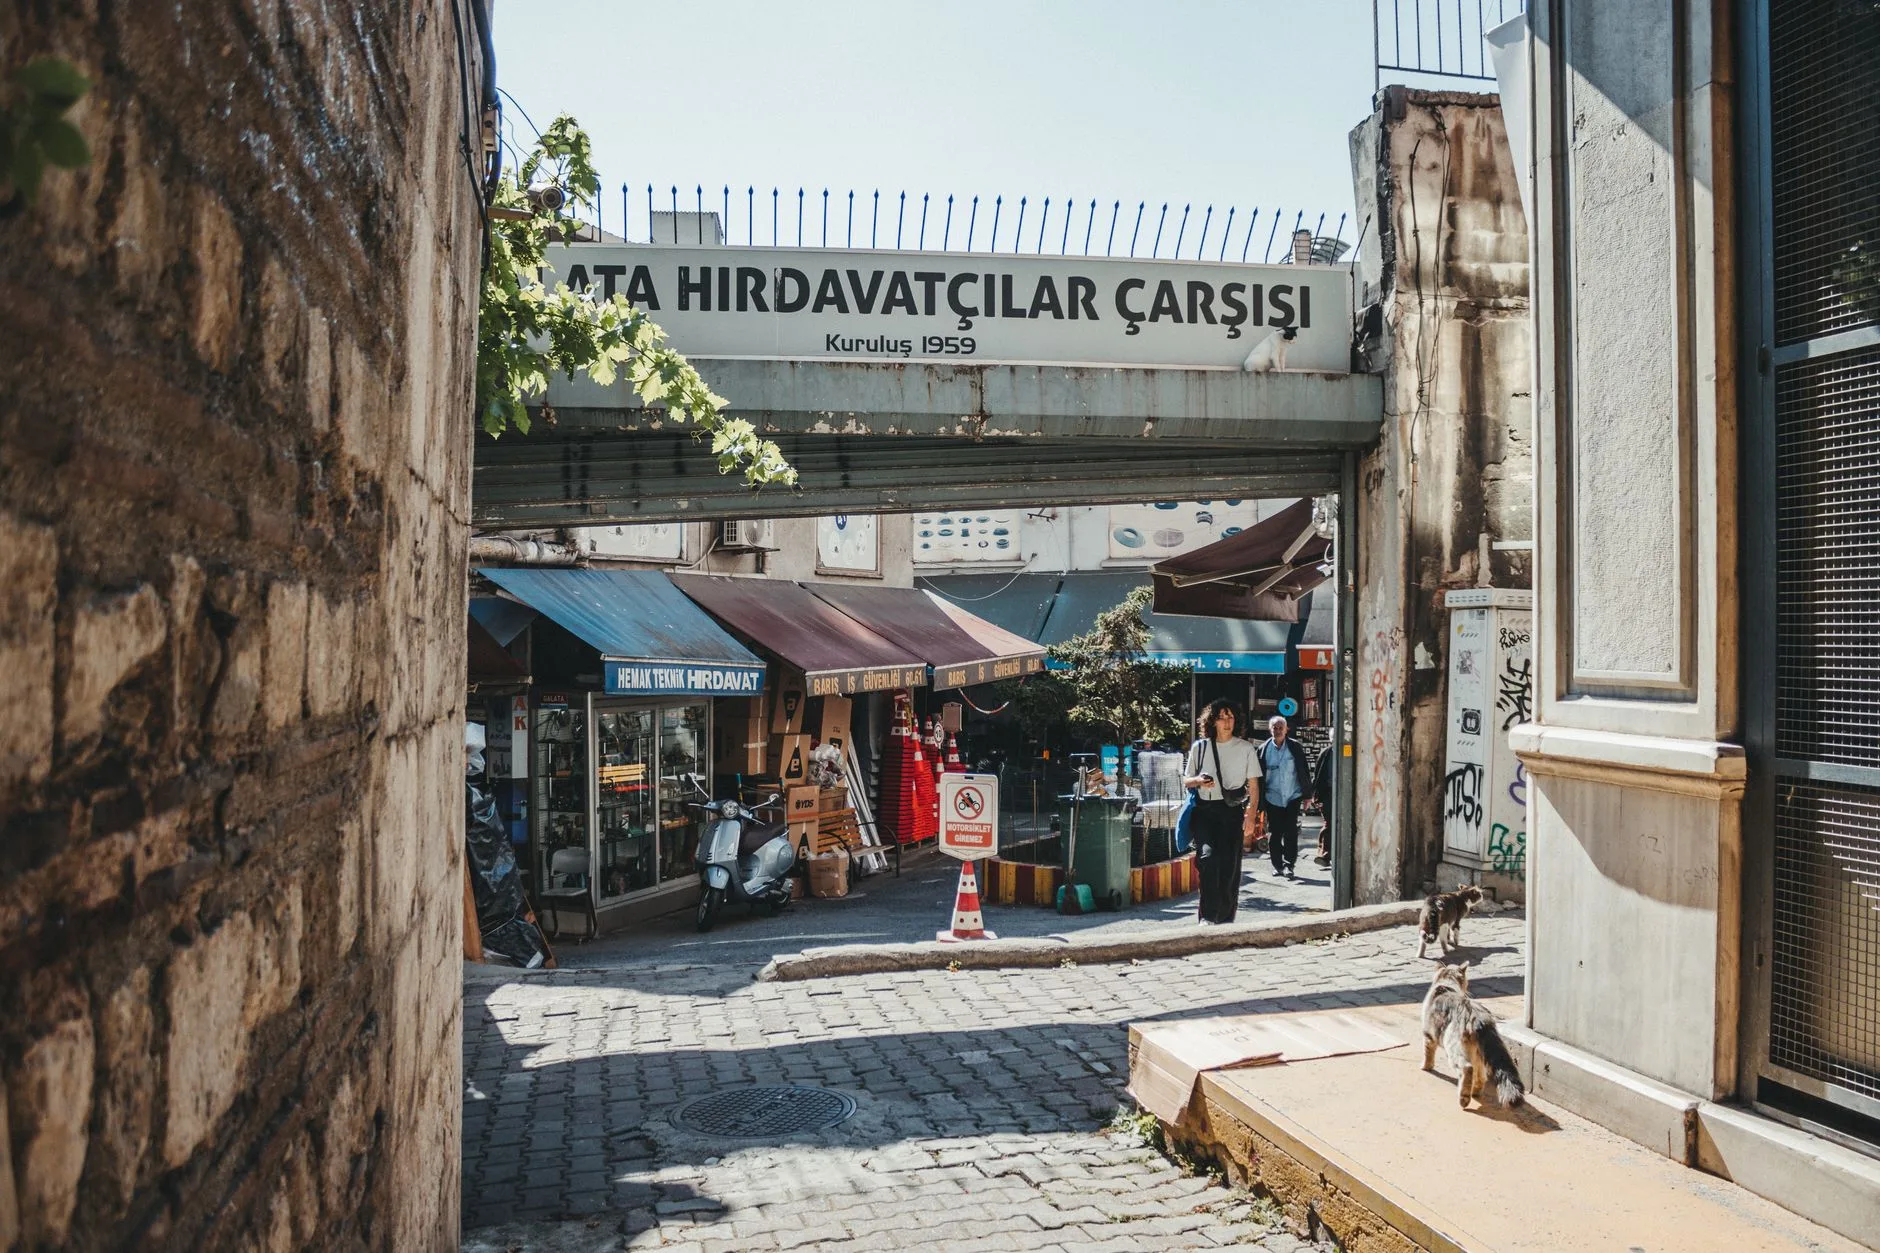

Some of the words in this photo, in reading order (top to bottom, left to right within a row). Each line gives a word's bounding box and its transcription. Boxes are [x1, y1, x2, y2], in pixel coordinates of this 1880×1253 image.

[678, 266, 1099, 331] HIRDAVATÇILAR
[1115, 278, 1310, 339] ÇARŞISI
[826, 334, 912, 358] Kuruluş
[922, 336, 976, 355] 1959
[1215, 658, 1231, 669] 76
[617, 667, 652, 689] HEMAK
[687, 669, 760, 691] HIRDAVAT
[847, 673, 856, 694] İŞ
[863, 669, 900, 690] GÜVENLİĞİ
[800, 799, 815, 809] YDS
[946, 823, 992, 833] MOTORSİKLET
[954, 833, 984, 844] GİREMEZ
